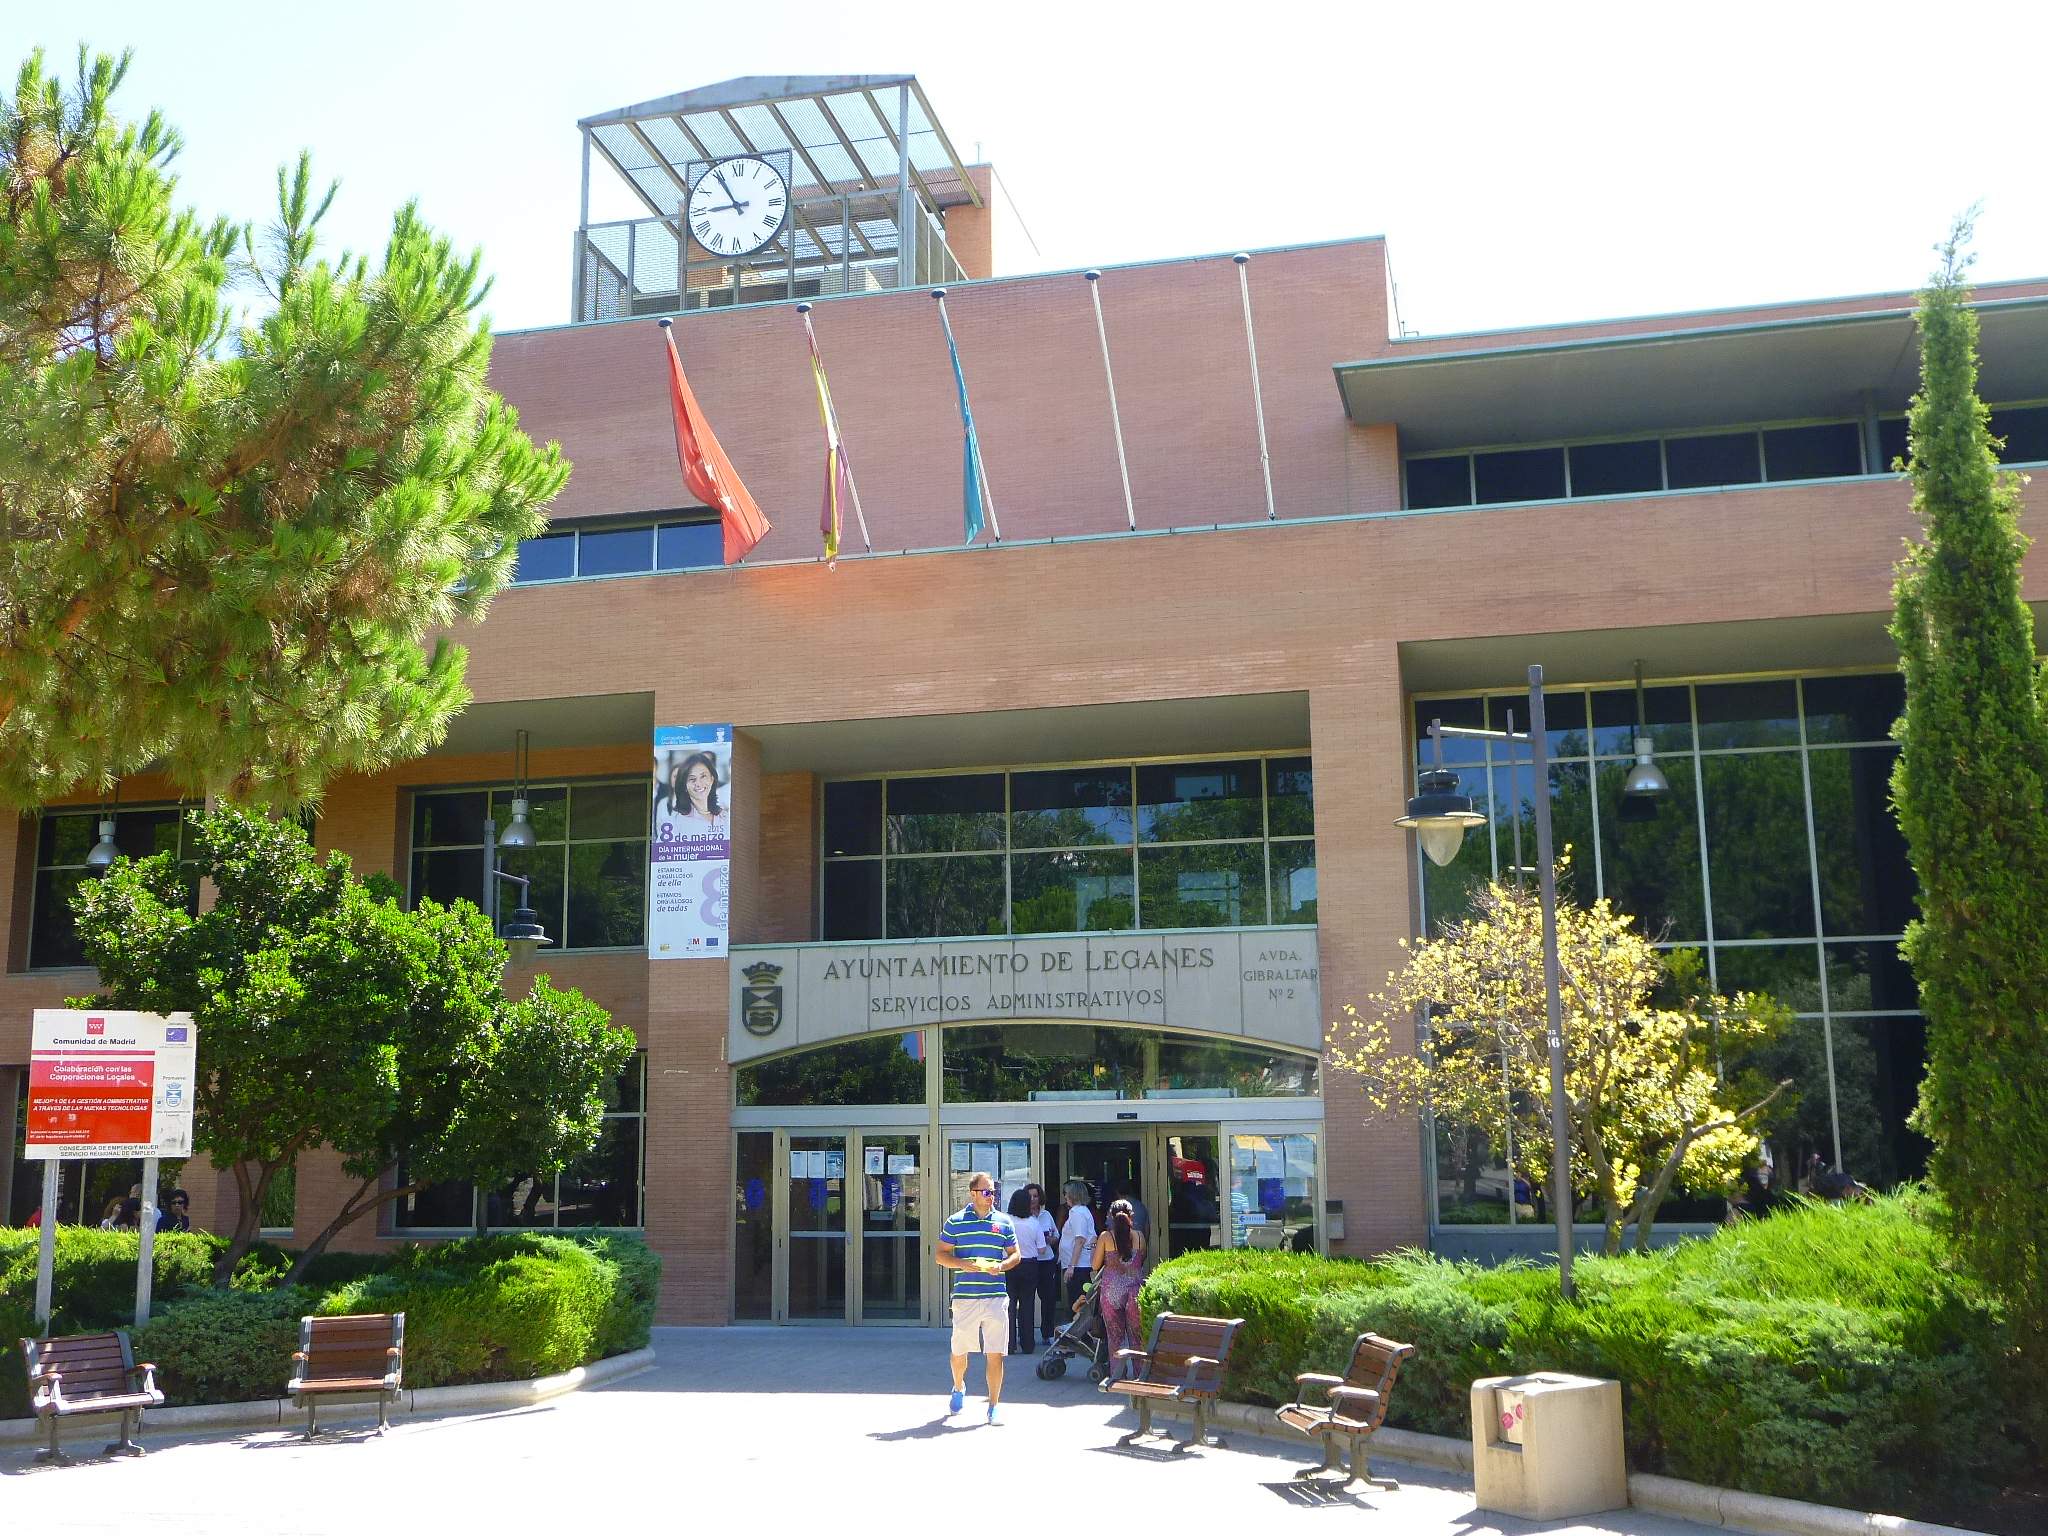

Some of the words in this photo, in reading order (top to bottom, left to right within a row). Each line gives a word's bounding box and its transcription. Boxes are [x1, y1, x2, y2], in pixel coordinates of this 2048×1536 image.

[660, 822, 674, 842] 8
[674, 832, 688, 842] de
[691, 833, 724, 842] marzo
[671, 844, 724, 853] INTERNACIONAL
[673, 852, 699, 861] mujer
[657, 879, 667, 887] de
[667, 879, 682, 887] ella
[656, 904, 668, 912] de
[1258, 950, 1302, 961] AVDA.
[823, 953, 1030, 980] AYUNTAMIENTO
[1040, 950, 1073, 973] DE
[1084, 947, 1215, 971] LEGANES
[1243, 968, 1318, 982] GIBRALTAR
[1287, 988, 1294, 999] 2
[871, 995, 971, 1013] SERVICIOS
[986, 988, 1164, 1010] ADMINISTRATIVOS
[53, 1065, 104, 1073] Colaboración
[120, 1065, 132, 1073] las
[49, 1073, 104, 1081] Corporaciones
[106, 1073, 136, 1081] Locales
